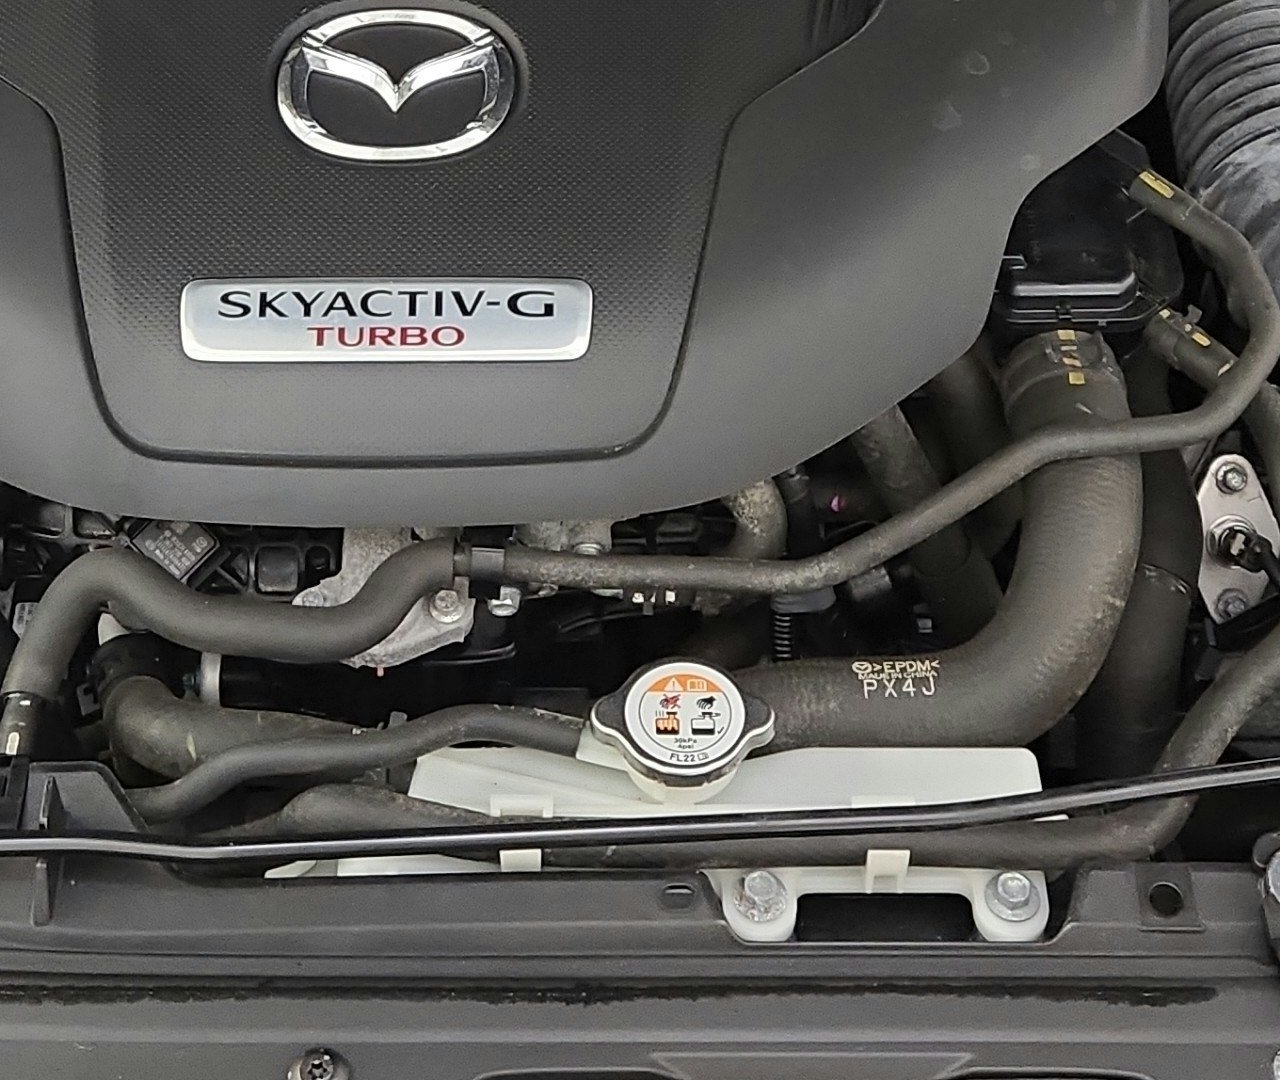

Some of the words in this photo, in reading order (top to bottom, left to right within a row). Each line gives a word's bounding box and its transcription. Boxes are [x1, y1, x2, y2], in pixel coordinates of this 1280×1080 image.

[217, 290, 556, 319] SKYACTIV-G
[306, 325, 465, 347] TURBO
[863, 675, 936, 699] PX4J
[670, 752, 696, 763] FL22
